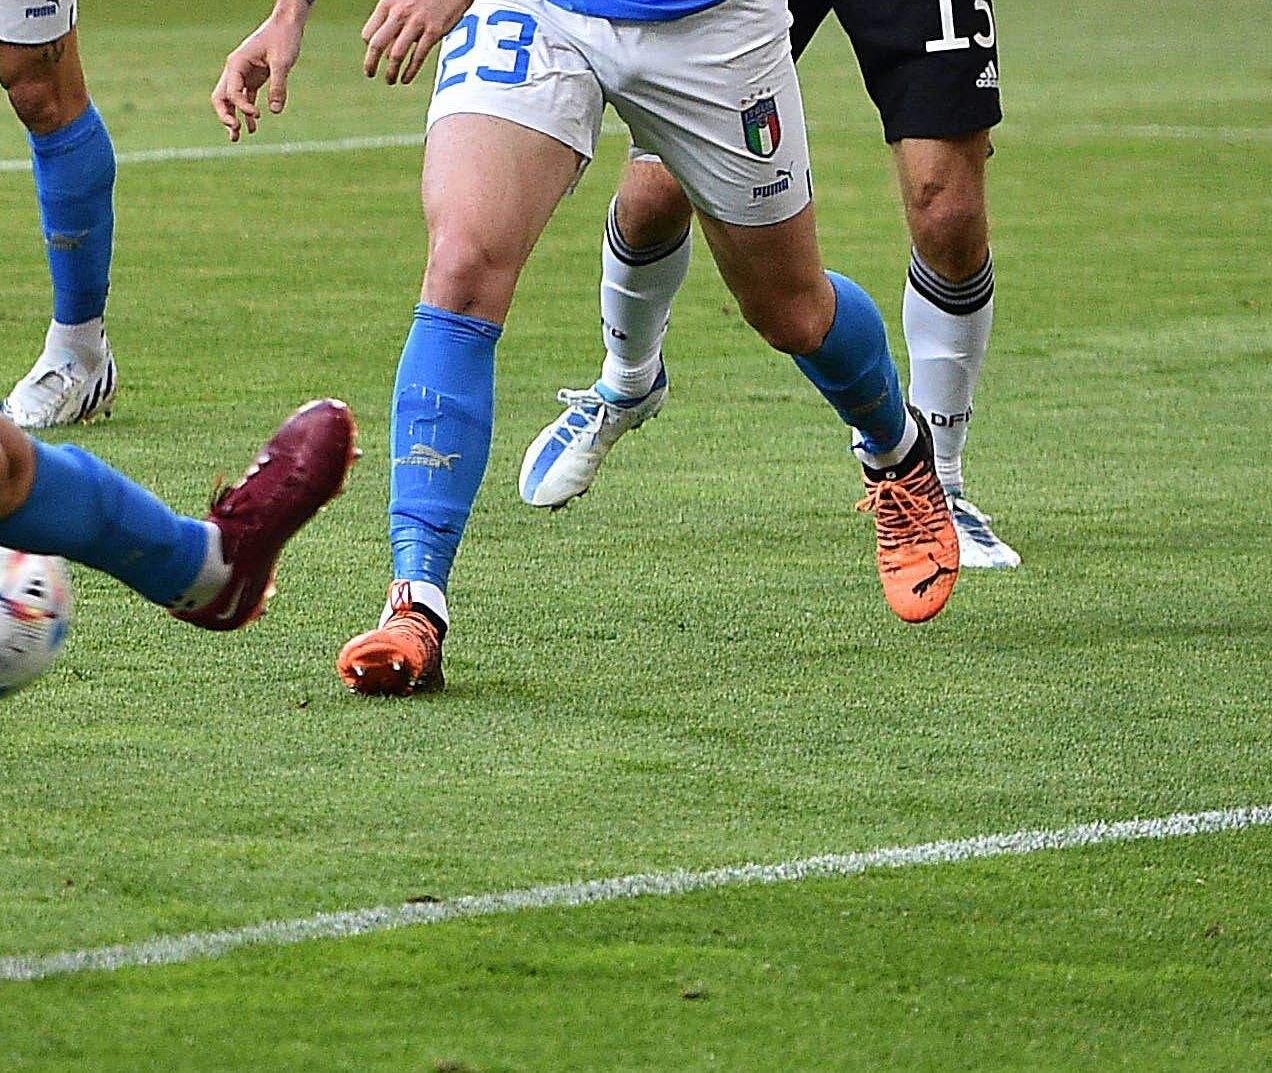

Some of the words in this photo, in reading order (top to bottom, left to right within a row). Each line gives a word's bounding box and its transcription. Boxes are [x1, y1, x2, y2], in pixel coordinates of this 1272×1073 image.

[25, 5, 57, 19] PUMA
[436, 9, 539, 96] 23
[752, 177, 790, 199] PUMA
